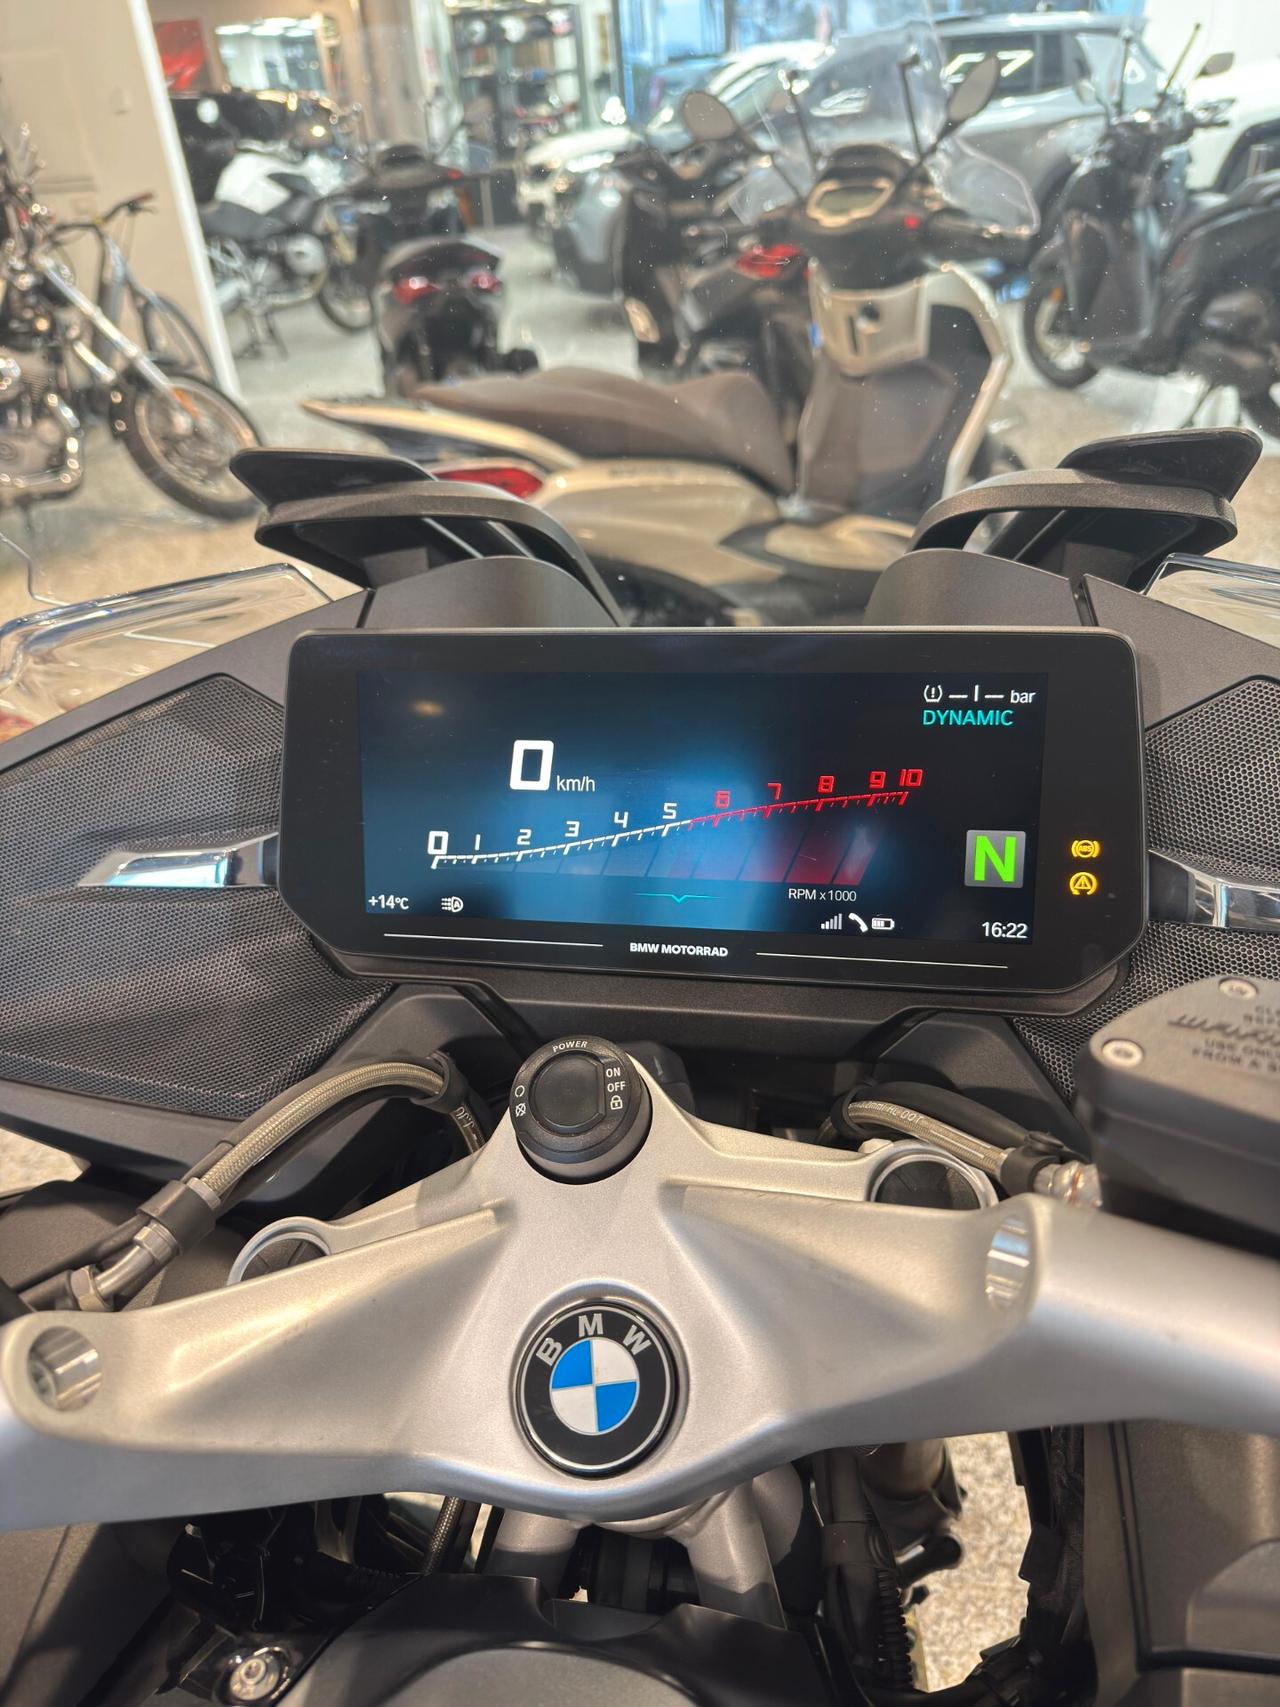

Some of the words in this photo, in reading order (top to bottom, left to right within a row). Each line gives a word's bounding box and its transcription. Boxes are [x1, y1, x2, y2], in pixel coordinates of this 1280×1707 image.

[1010, 689, 1035, 704] bar
[922, 709, 1013, 727] DYNAMIC
[509, 739, 554, 791] 0
[556, 775, 596, 792] km/h
[427, 830, 449, 855] 0
[475, 834, 481, 851] 1
[516, 829, 531, 845] 2
[565, 821, 580, 837] 3
[613, 811, 629, 828] 4
[663, 802, 677, 819] 5
[714, 790, 731, 808] 6
[767, 782, 782, 799] 7
[818, 775, 835, 793] 8
[869, 771, 886, 788] 9
[899, 768, 924, 788] 10
[973, 835, 1018, 883] N
[368, 894, 410, 910] +14°C
[788, 888, 816, 900] RPM
[981, 921, 1028, 939] 16:22
[629, 942, 659, 955] BMW
[661, 943, 729, 958] MOTORRAD
[552, 1040, 588, 1053] POWER
[606, 1067, 621, 1078] ON
[607, 1080, 626, 1093] OFF
[535, 1313, 652, 1367] BMW
